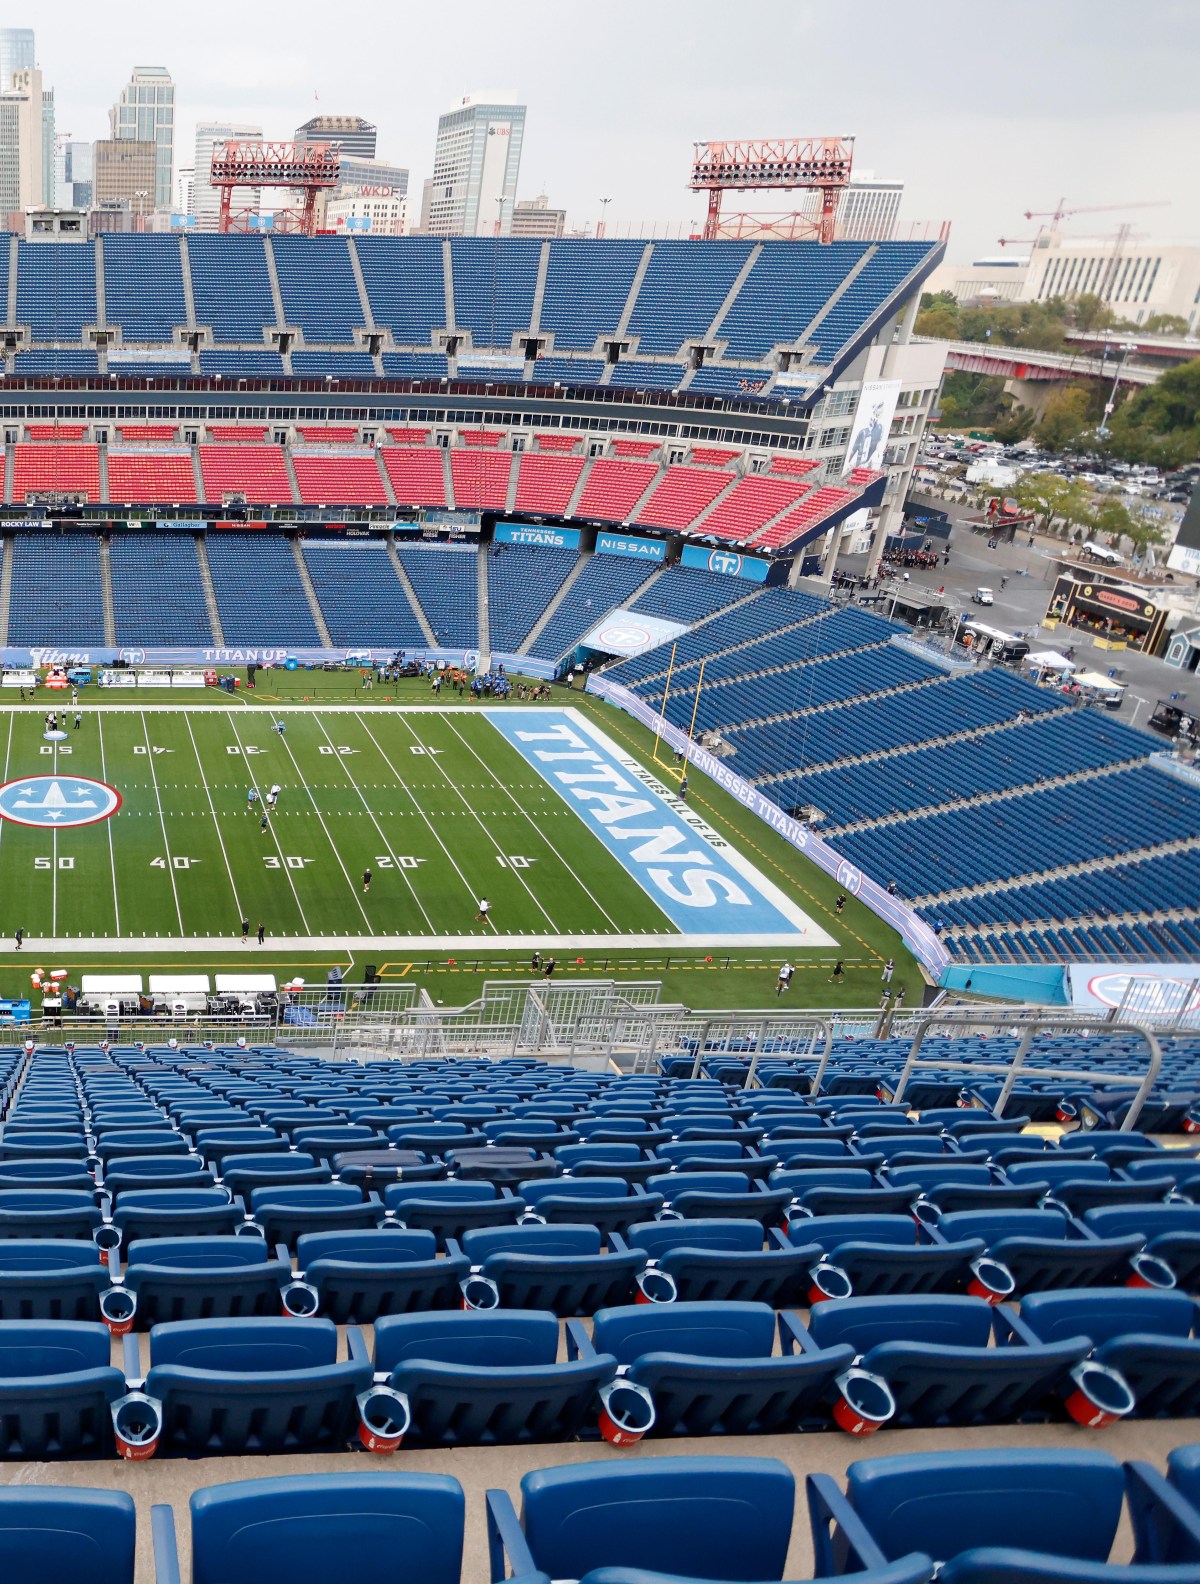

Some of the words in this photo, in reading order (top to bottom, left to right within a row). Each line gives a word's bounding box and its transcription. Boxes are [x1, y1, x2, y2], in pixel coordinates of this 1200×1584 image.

[496, 127, 510, 136] UBS
[359, 185, 400, 197] WKDF
[520, 527, 556, 535] TENNESSEE
[510, 531, 564, 546] TITANS
[600, 538, 661, 556] NISSAN
[29, 647, 90, 664] Titans
[203, 649, 260, 661] TITAN
[260, 649, 288, 661] UP
[39, 746, 73, 755] 50
[133, 746, 166, 755] 40
[226, 746, 261, 755] 30
[318, 746, 353, 755] 20
[409, 746, 439, 755] 10
[686, 743, 756, 806] TENNESSEE
[758, 799, 809, 848] TITANS
[620, 759, 638, 767] IT
[633, 769, 670, 795] TAKES
[665, 798, 687, 815] ALL
[687, 818, 709, 831] OF
[702, 834, 728, 848] US
[514, 724, 753, 908] TITANS
[34, 857, 75, 869] 50
[149, 857, 190, 869] 40
[262, 857, 305, 869] 30
[375, 856, 419, 868] 20
[496, 856, 530, 868] 10
